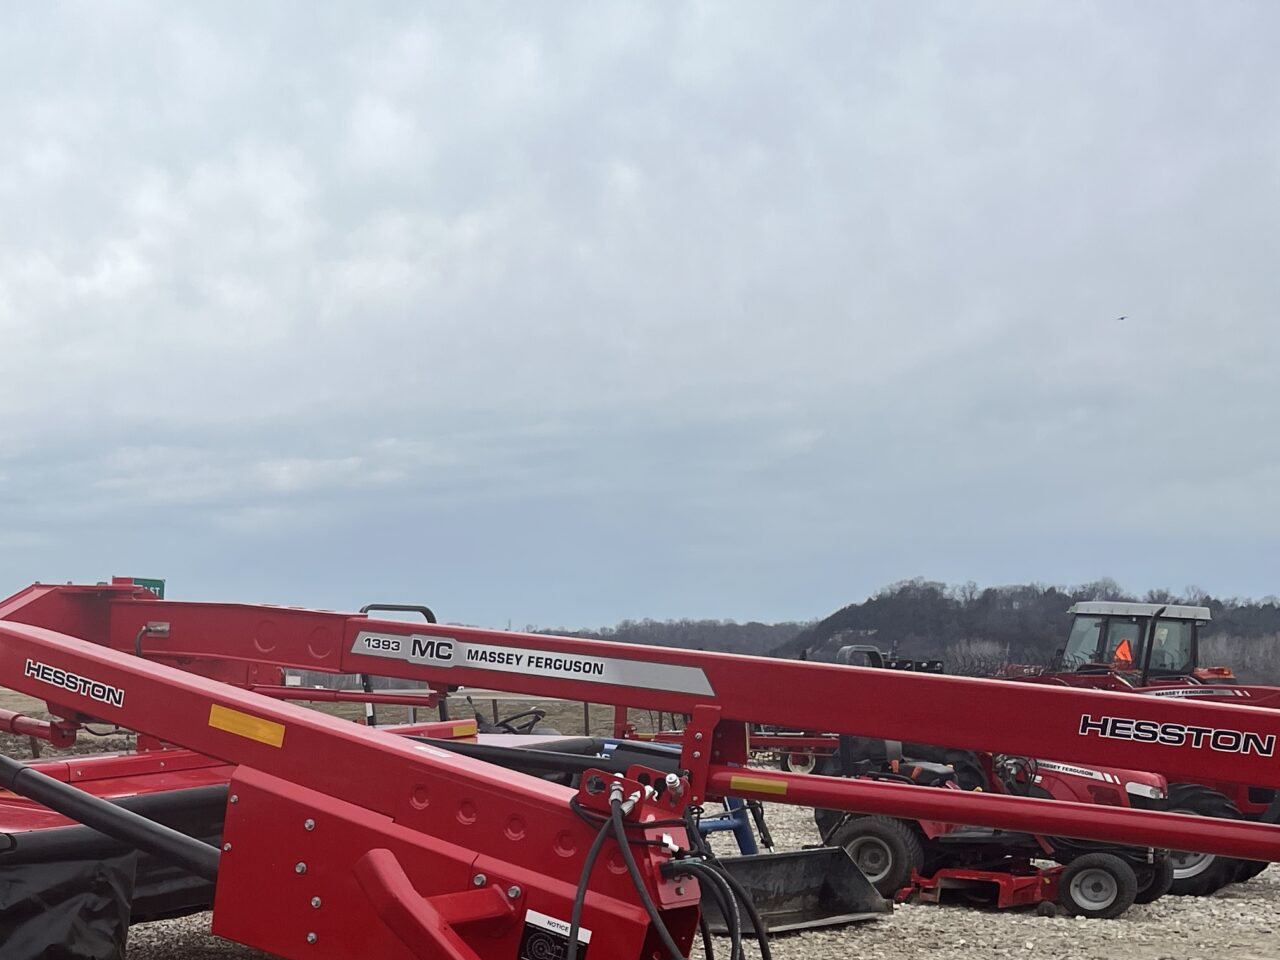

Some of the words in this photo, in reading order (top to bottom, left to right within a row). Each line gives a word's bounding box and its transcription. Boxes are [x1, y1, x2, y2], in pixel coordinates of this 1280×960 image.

[364, 637, 401, 651] 1393
[411, 639, 453, 660] MC
[466, 648, 523, 666] MASSEY
[527, 655, 605, 676] FERGUSON
[25, 659, 125, 707] HESSTON
[1079, 714, 1276, 757] HESSTON
[1036, 761, 1061, 770] MASSEY
[1061, 766, 1094, 777] FERGUSON
[546, 919, 570, 933] NOTICE
